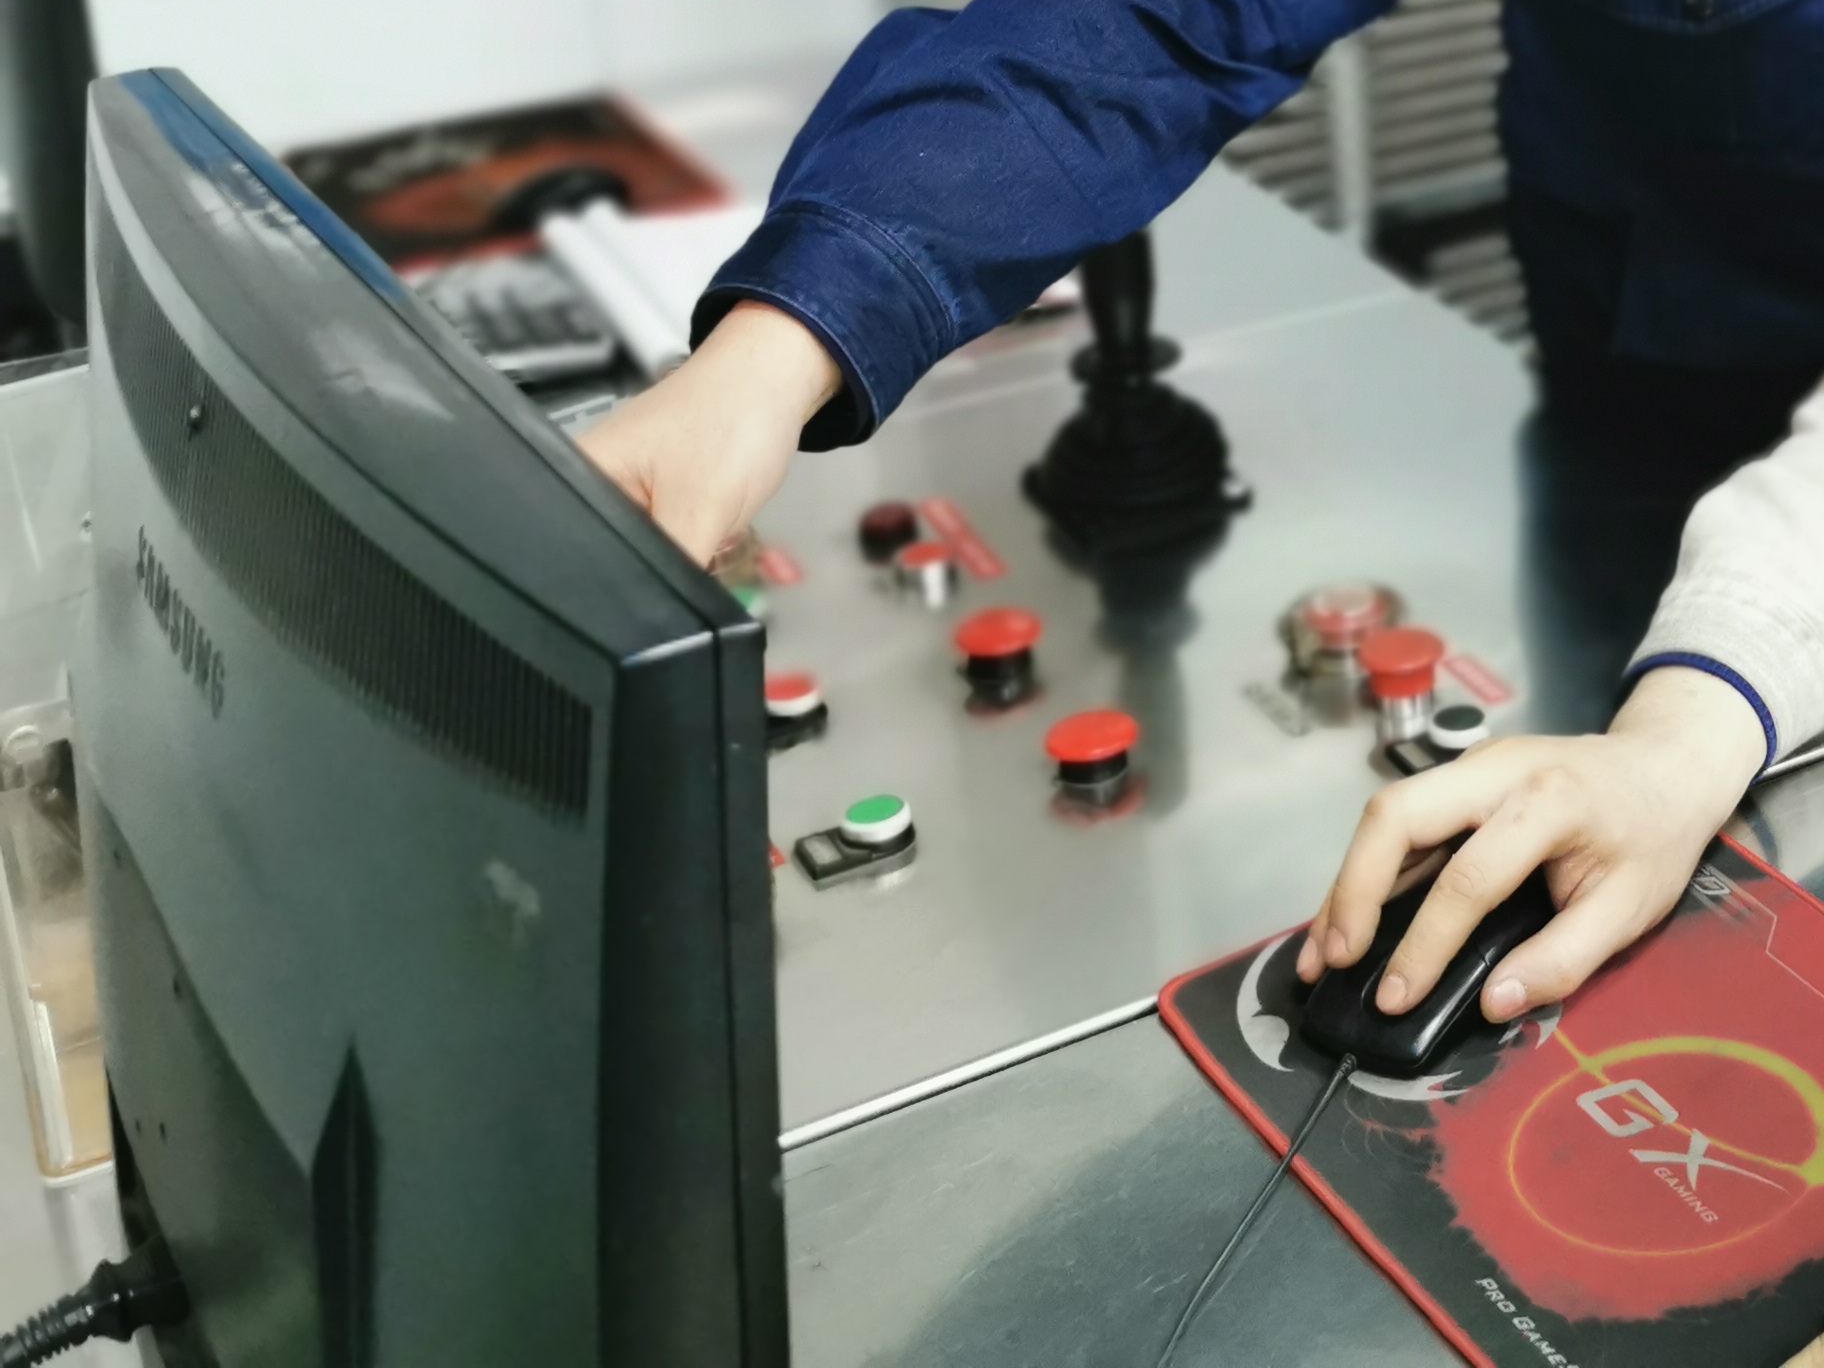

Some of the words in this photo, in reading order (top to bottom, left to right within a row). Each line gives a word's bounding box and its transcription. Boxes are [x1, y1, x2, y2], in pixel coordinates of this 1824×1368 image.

[1576, 1079, 1788, 1192] GX
[1653, 1166, 1719, 1224] GAMING
[1475, 1277, 1517, 1313] PRO
